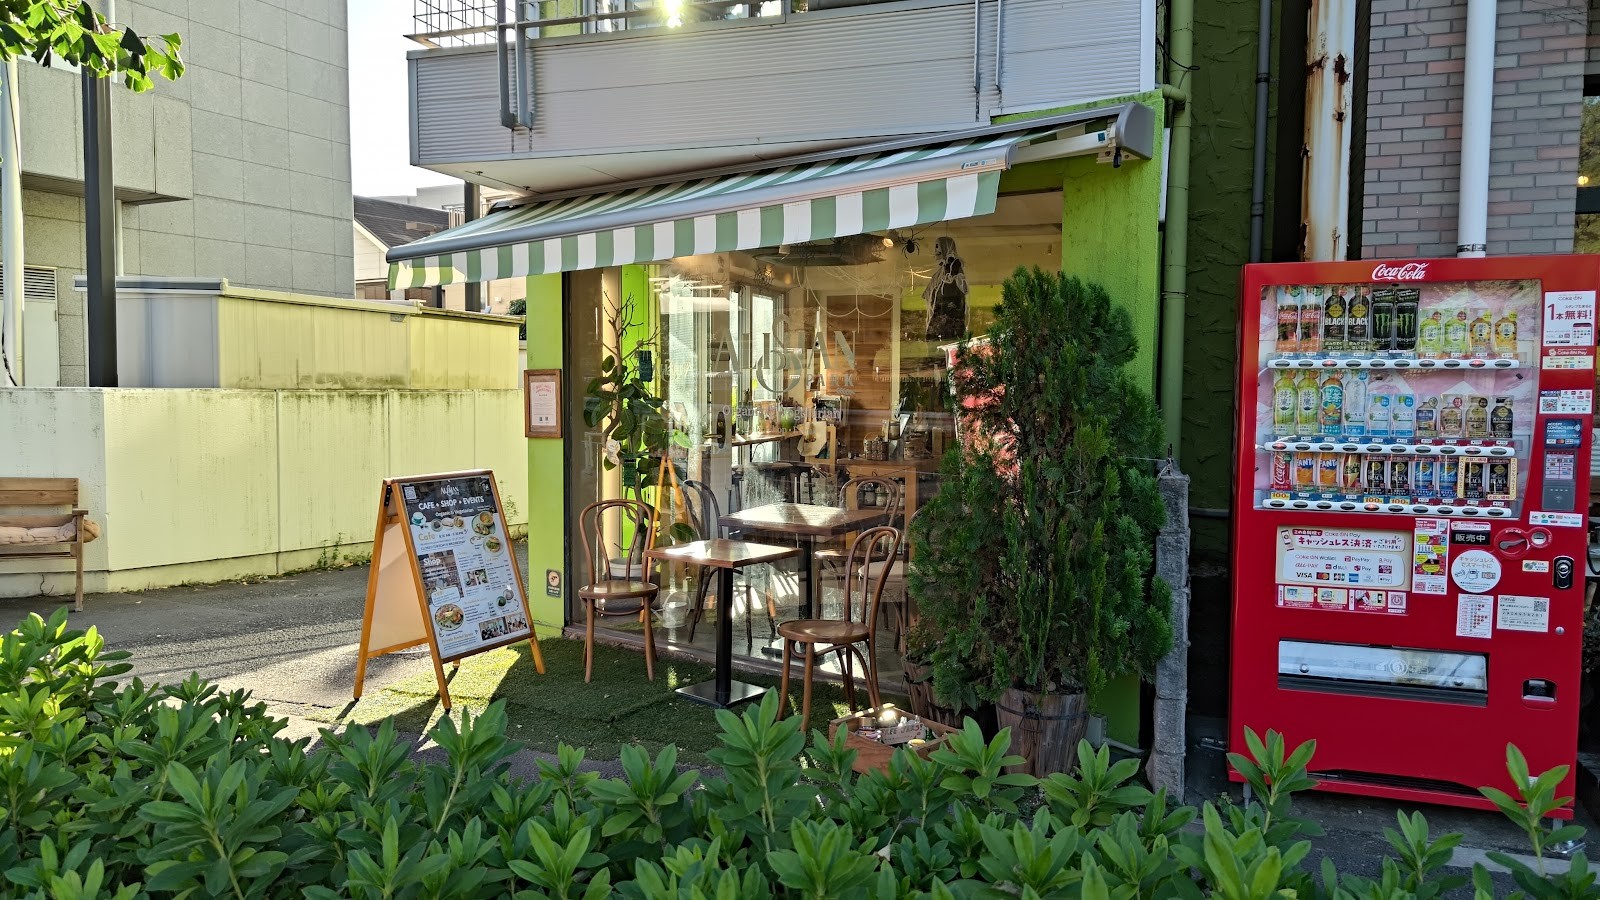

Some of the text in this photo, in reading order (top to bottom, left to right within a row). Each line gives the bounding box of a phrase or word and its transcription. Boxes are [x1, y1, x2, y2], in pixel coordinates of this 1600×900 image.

[1371, 263, 1430, 281] Coca-Cola
[1324, 318, 1345, 326] BLACK
[1348, 318, 1369, 326] BLACK
[806, 372, 855, 389] PARK
[418, 496, 485, 510] CAFE SHOP EVENTS
[418, 532, 435, 542] Cafe
[1349, 532, 1361, 540] Pay
[1455, 533, 1486, 543] 販売中
[1298, 536, 1372, 548] キャッシュレス決済
[423, 558, 441, 567] Shop
